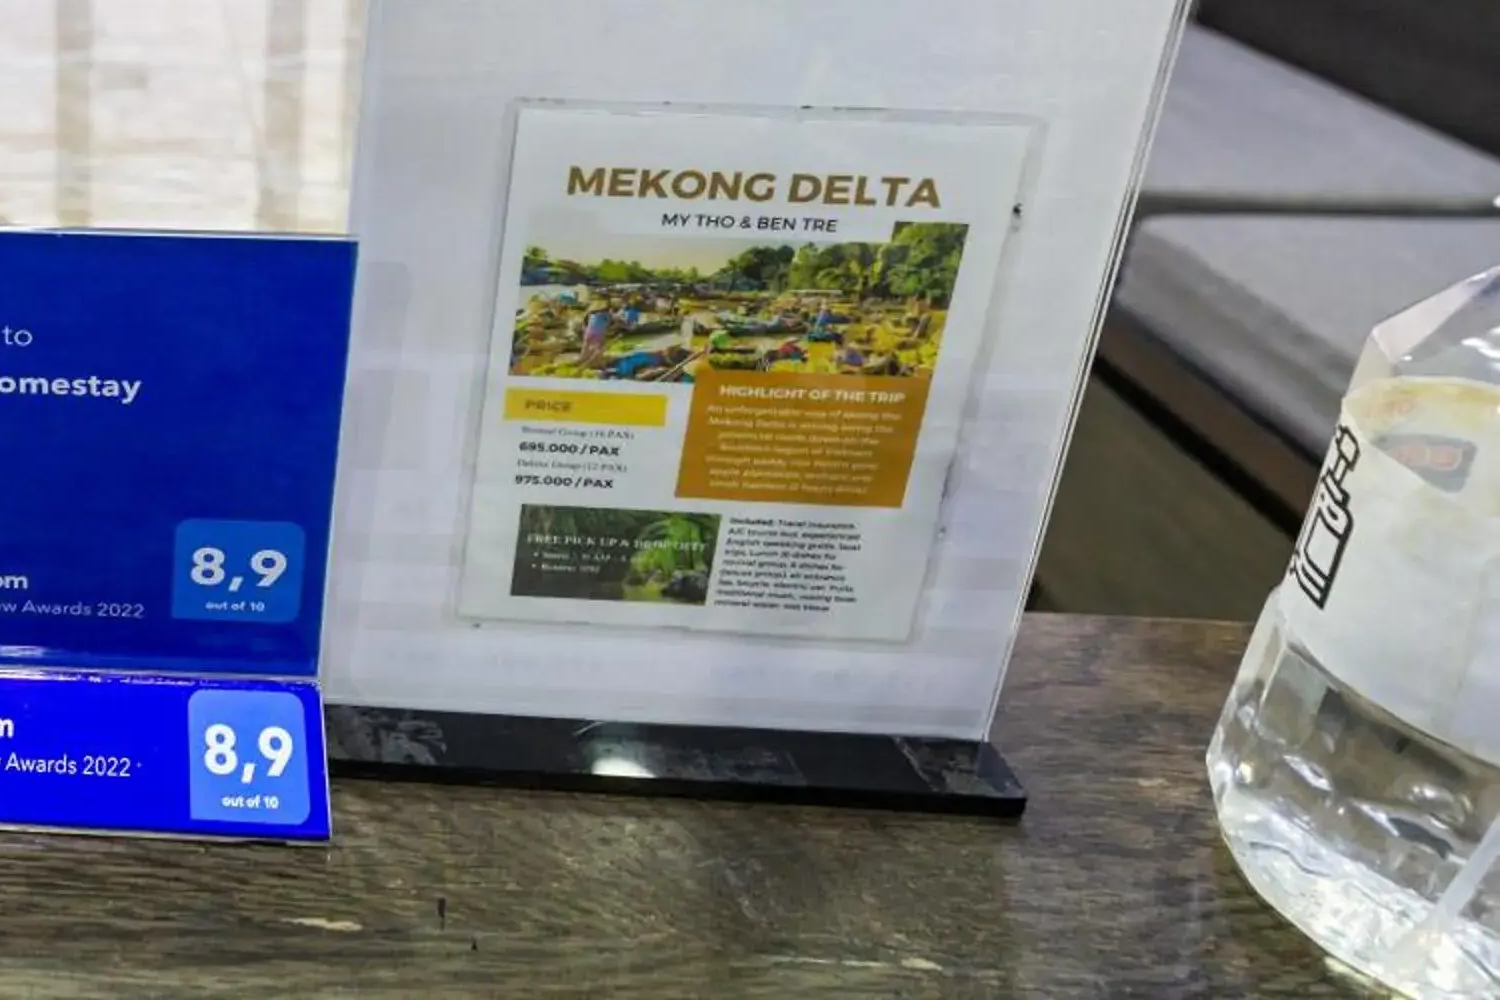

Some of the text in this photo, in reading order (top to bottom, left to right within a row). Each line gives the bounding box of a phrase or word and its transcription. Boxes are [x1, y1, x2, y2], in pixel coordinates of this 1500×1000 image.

[566, 166, 941, 208] MEKONG DELTA
[661, 213, 838, 233] MY THO & BEN TRE
[3, 325, 33, 346] to
[720, 385, 905, 404] HIGHLIGHT OF THE TRIP
[525, 399, 572, 412] PRICE
[190, 547, 287, 592] 8,9
[22, 600, 91, 616] Awards
[97, 603, 144, 618] 2022
[205, 601, 265, 612] out of 10
[204, 724, 293, 784] 8,9
[5, 752, 77, 775] Awards
[83, 756, 131, 777] 2022
[221, 796, 279, 809] out of 10
